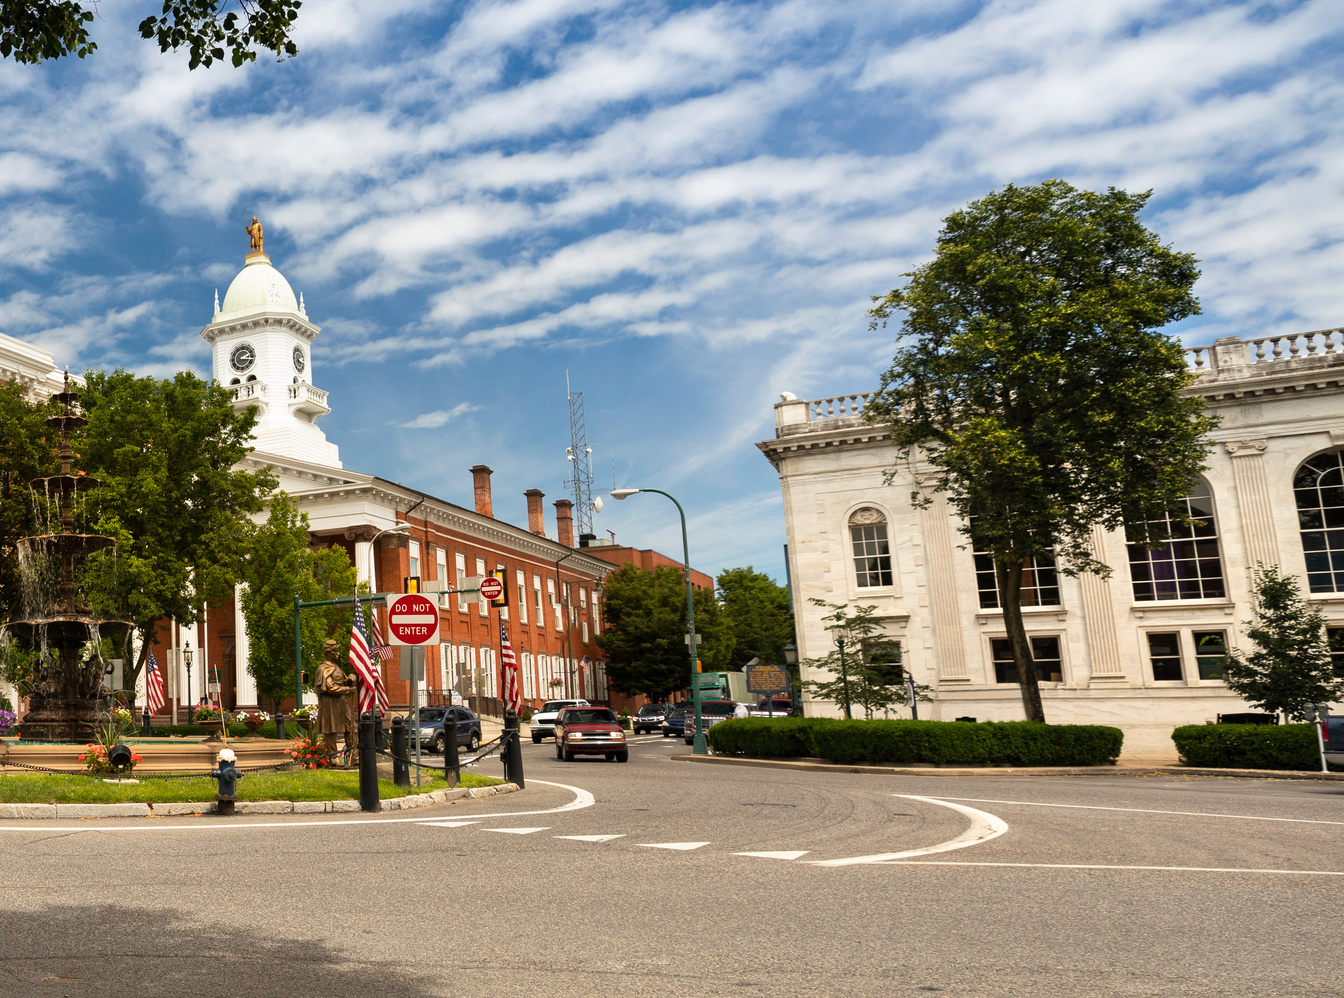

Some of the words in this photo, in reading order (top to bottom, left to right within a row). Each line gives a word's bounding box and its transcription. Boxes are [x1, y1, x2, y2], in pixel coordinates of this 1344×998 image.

[395, 604, 407, 612] DO
[413, 604, 430, 612] NOT
[399, 627, 427, 635] ENTER
